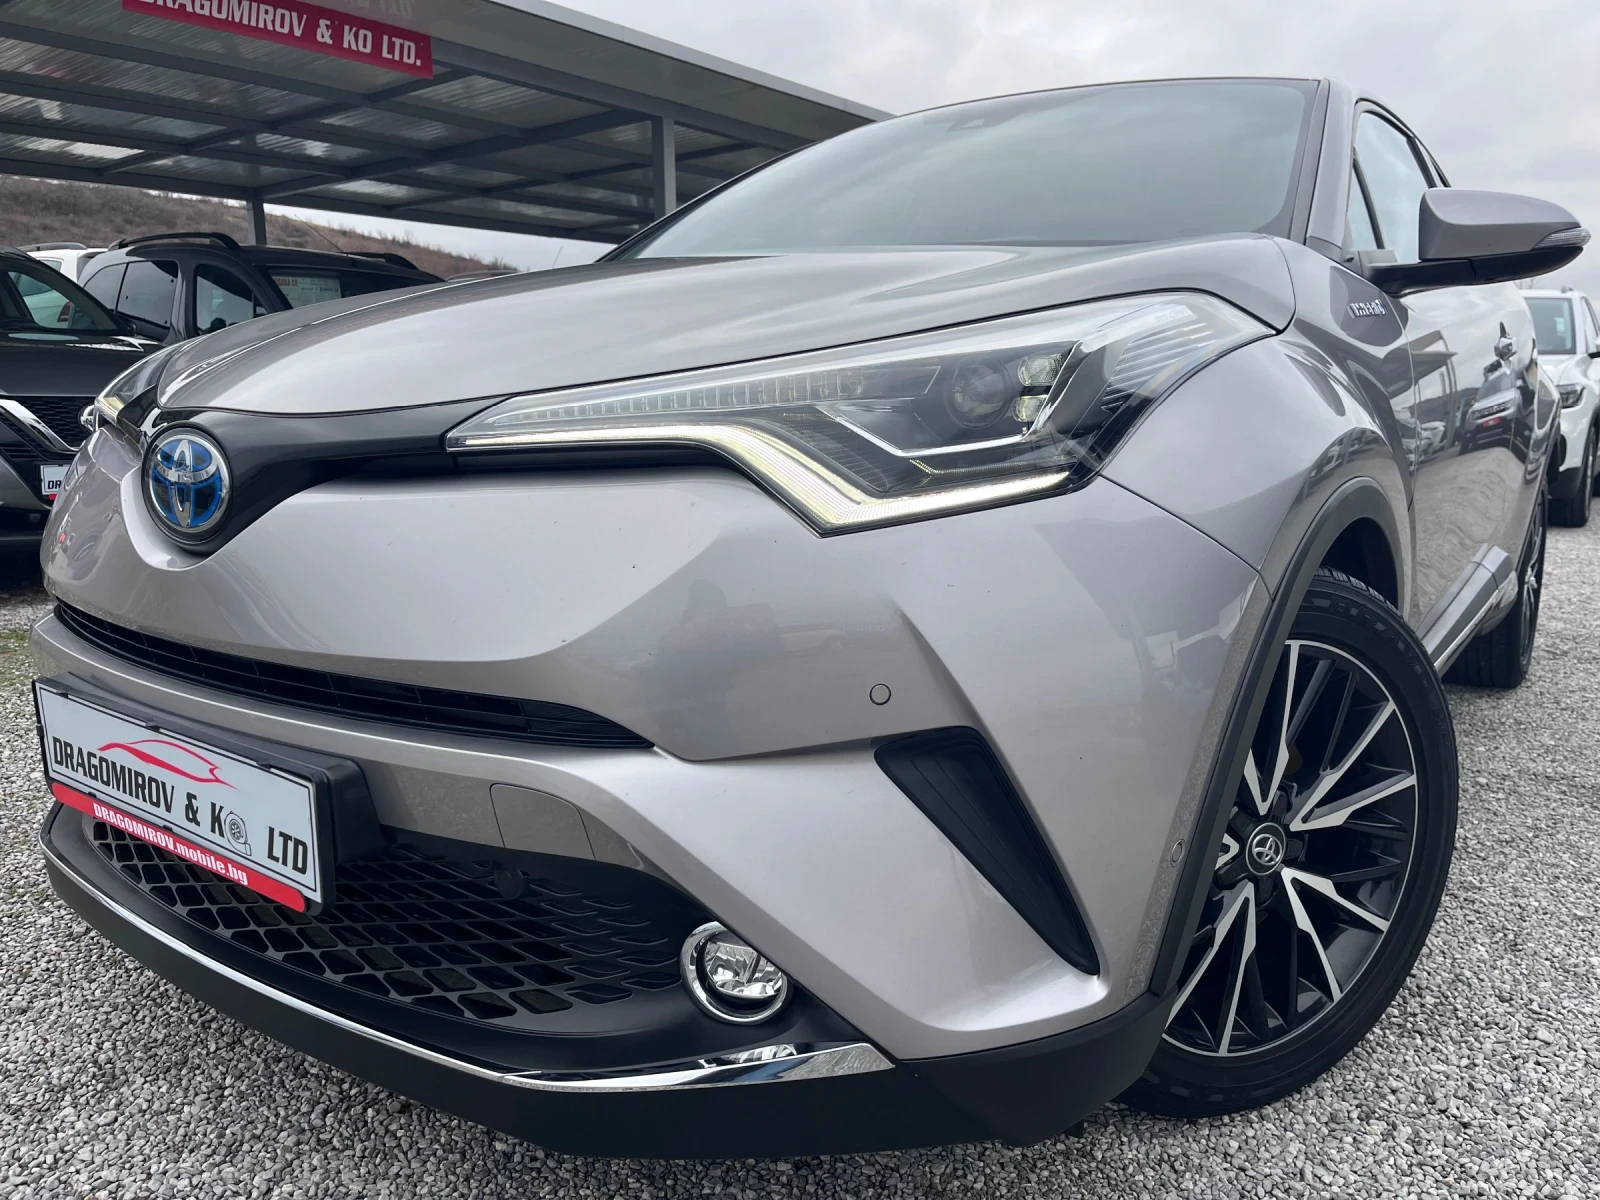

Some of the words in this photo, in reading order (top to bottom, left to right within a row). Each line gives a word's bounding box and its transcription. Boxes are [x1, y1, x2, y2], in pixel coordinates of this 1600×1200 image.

[316, 18, 333, 45] &
[342, 24, 373, 54] KO
[381, 34, 422, 67] LTD.
[52, 736, 175, 814] DRAGOMIROV
[185, 791, 201, 828] &
[267, 825, 309, 876] LTD
[92, 802, 249, 886] DRAGOMIROV.mobile.bg
